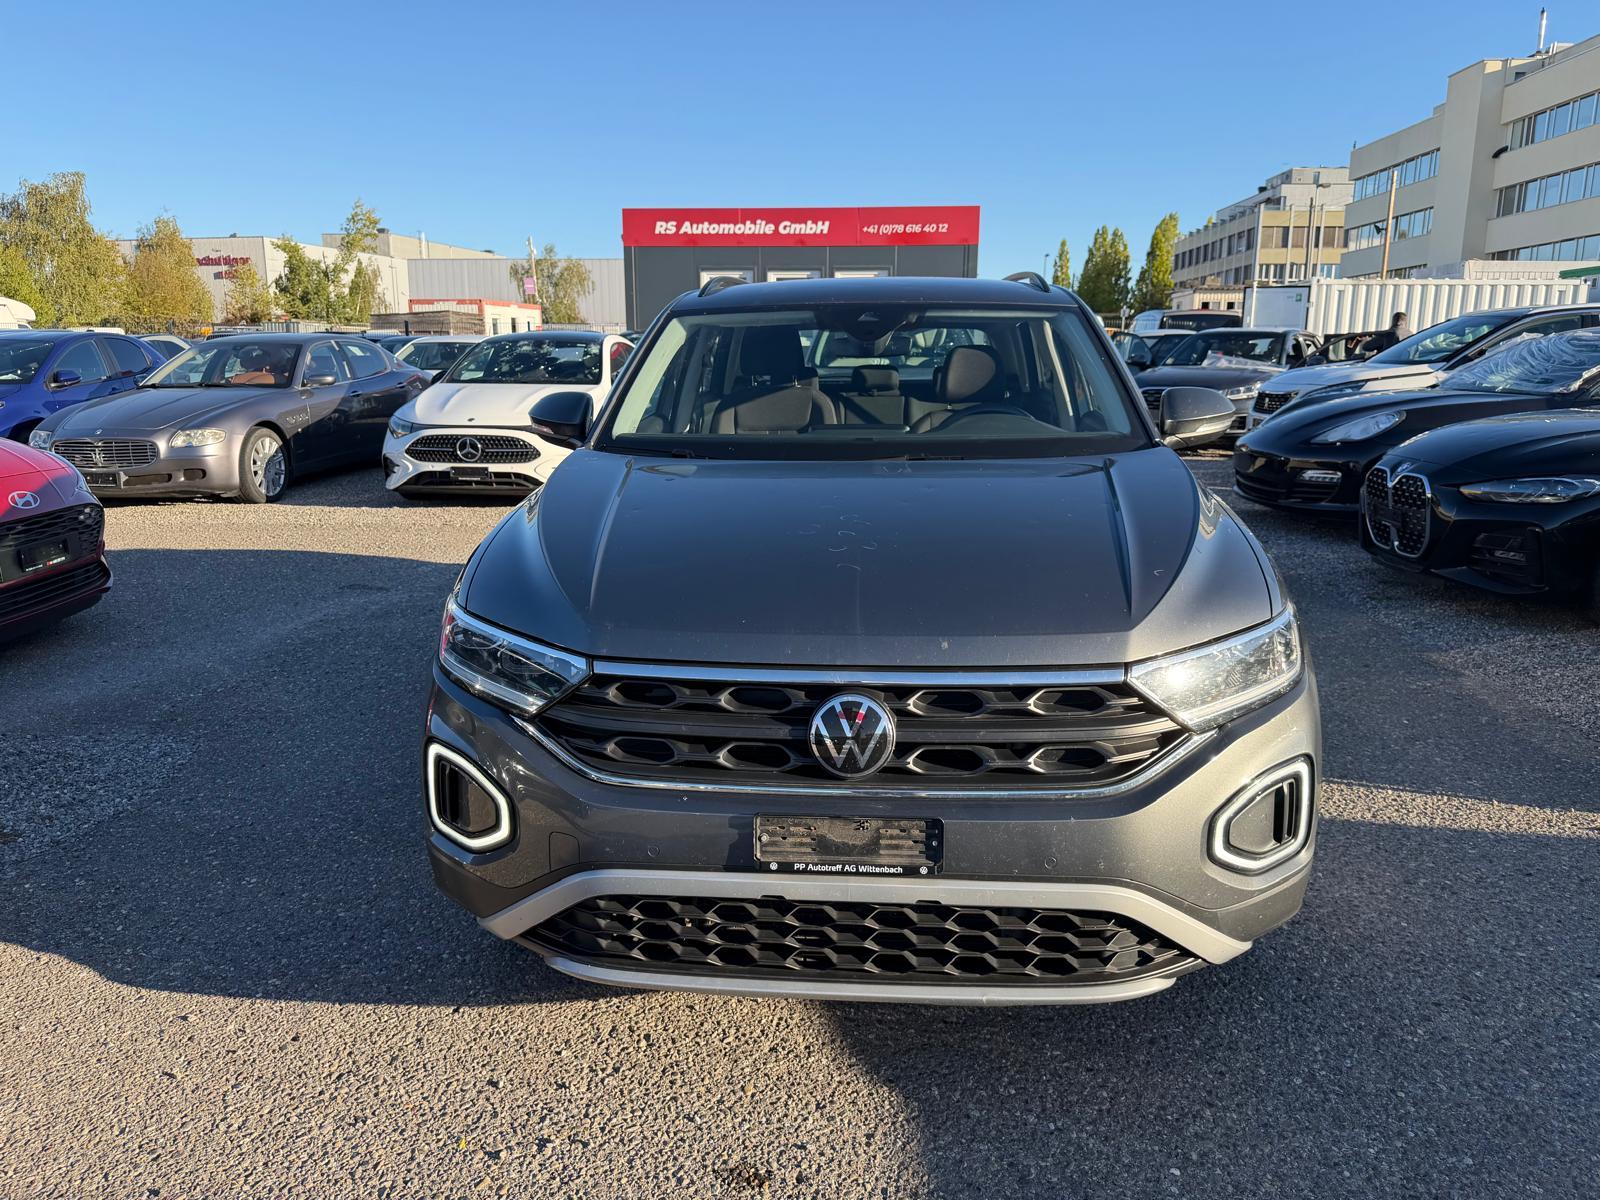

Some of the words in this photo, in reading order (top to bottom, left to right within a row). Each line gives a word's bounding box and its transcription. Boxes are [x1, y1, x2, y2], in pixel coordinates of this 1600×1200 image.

[655, 221, 677, 235] RS
[679, 219, 776, 235] Automobile
[778, 220, 830, 235] GmbH
[862, 224, 878, 235] +41
[879, 223, 904, 236] (0)78
[905, 223, 922, 234] 616
[923, 223, 937, 233] 40
[938, 223, 949, 233] 12
[794, 863, 806, 871] PP
[807, 863, 843, 872] Autotreff
[844, 864, 857, 873] AG
[858, 865, 903, 874] Wittenbach
